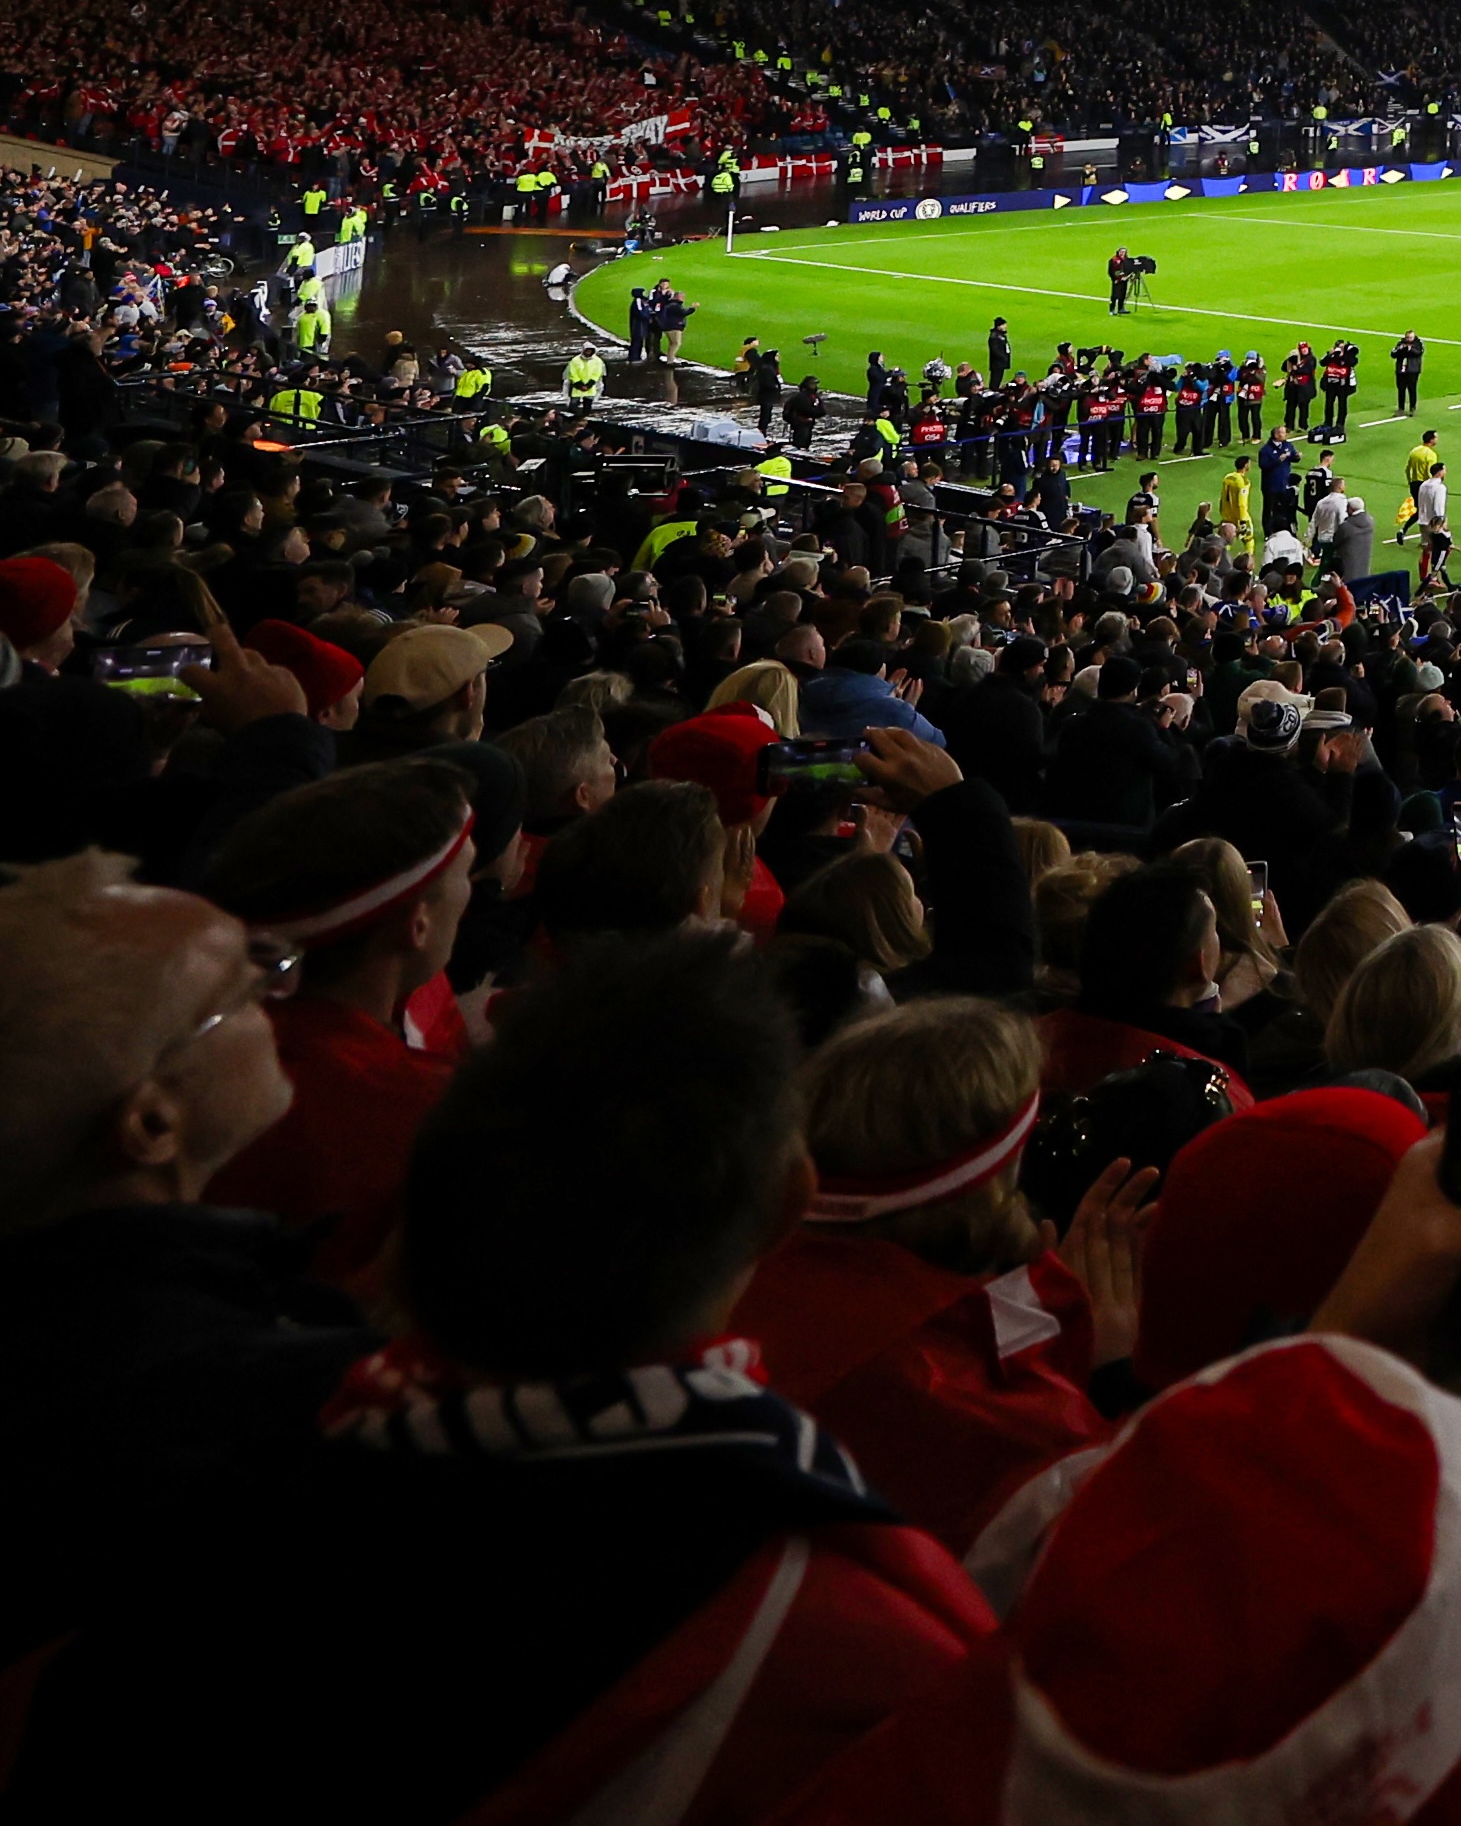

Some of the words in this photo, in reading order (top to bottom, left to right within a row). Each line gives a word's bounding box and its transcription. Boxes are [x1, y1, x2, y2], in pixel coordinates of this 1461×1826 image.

[858, 210, 888, 222] WORLD
[890, 206, 907, 219] CUP
[950, 202, 996, 214] QUALIFIERS
[1309, 479, 1317, 496] 3
